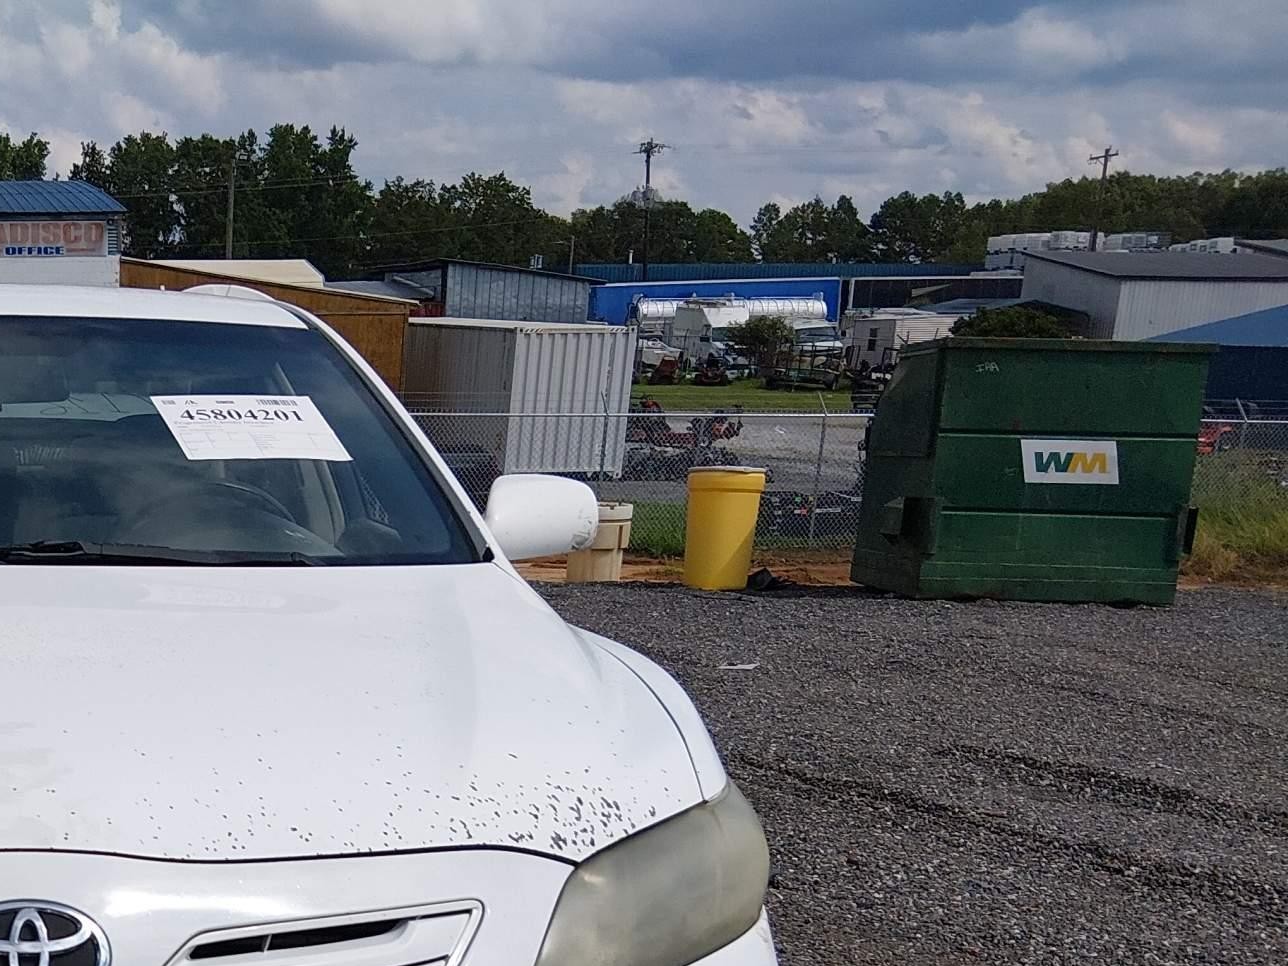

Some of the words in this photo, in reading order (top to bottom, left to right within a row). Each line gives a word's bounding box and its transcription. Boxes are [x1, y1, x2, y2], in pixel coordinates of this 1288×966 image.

[4, 246, 65, 256] OFFICE
[180, 408, 305, 422] 45804201
[1033, 451, 1108, 474] WM
